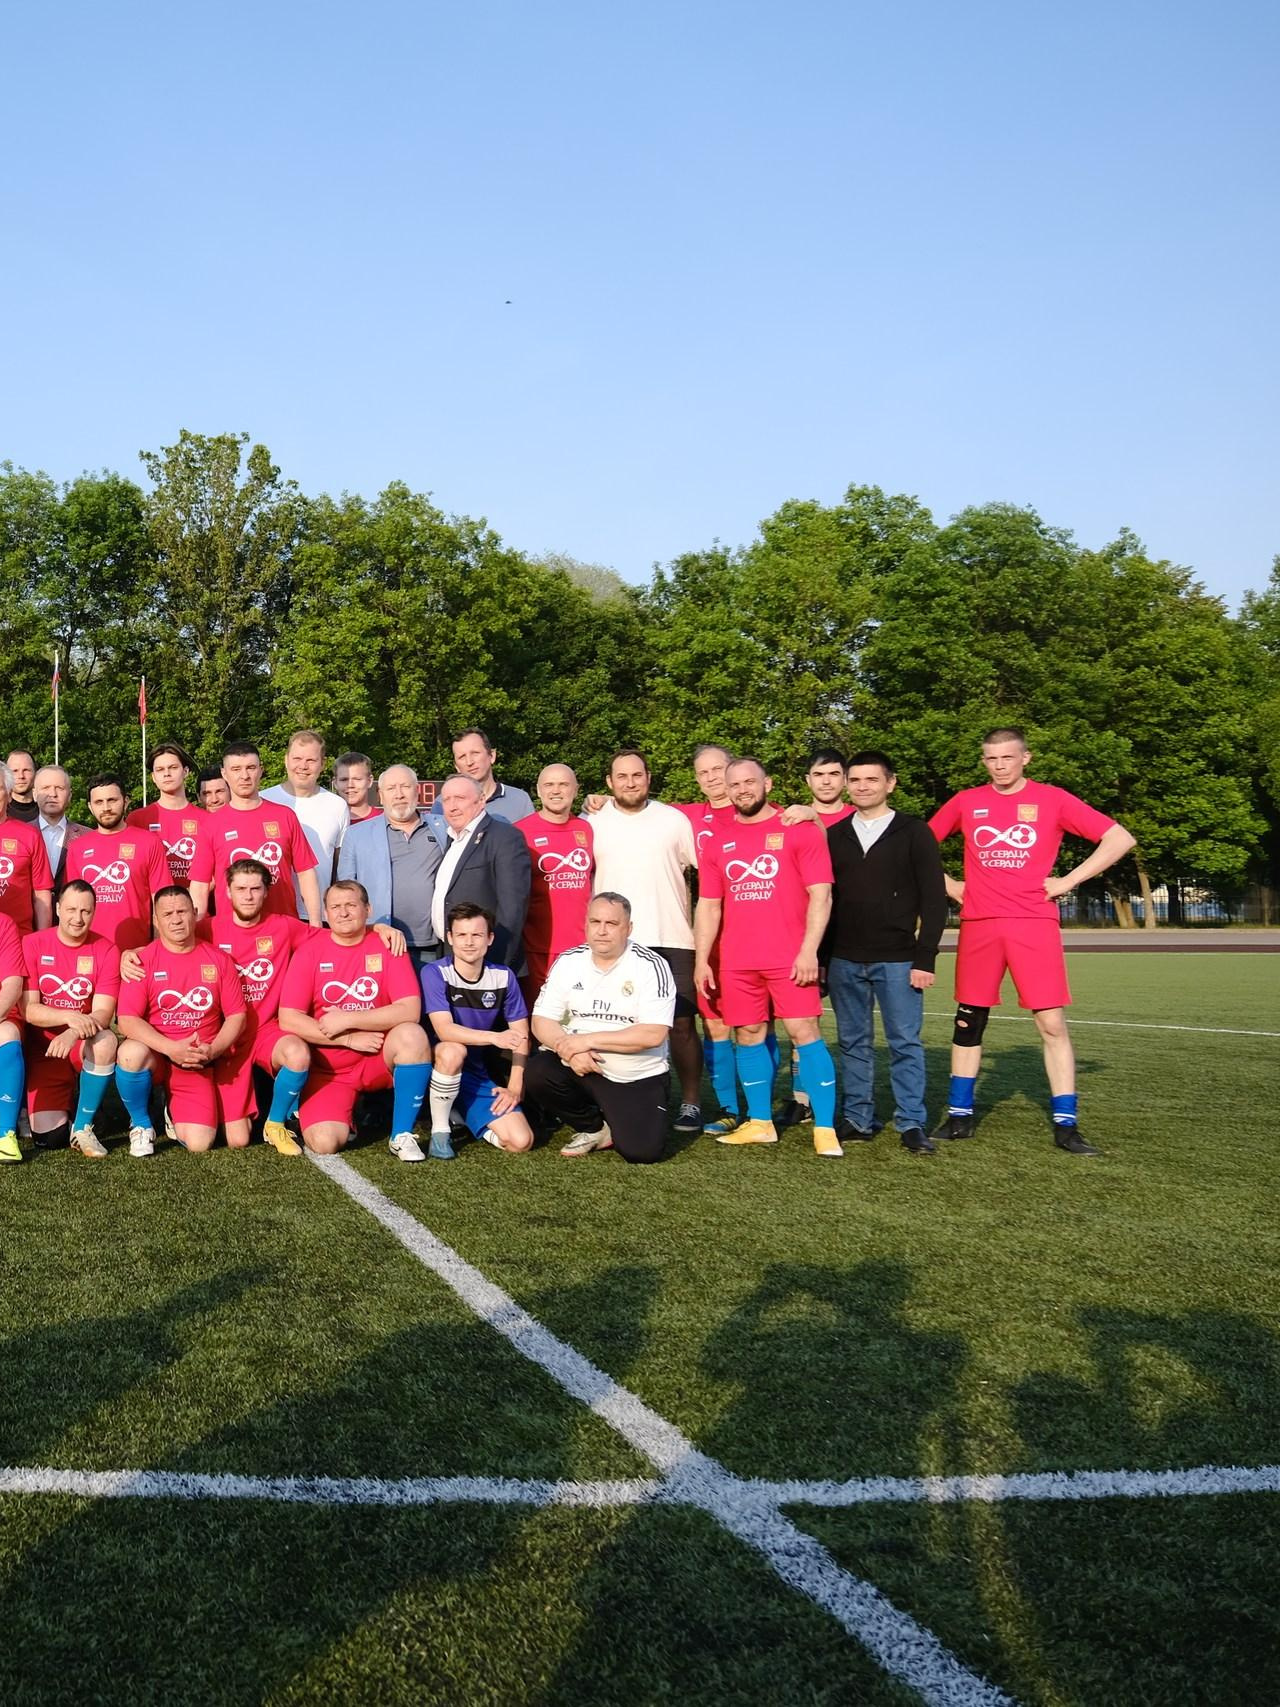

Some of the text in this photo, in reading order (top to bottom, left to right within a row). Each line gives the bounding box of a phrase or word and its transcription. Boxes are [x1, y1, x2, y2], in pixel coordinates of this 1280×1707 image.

[979, 850, 1030, 859] ОТ СЕРДЦА
[988, 860, 1026, 869] СЕРДЦУ
[544, 872, 587, 882] ОТ СЕРДЦА
[556, 881, 586, 889] СЕРДЦУ
[730, 881, 776, 893] ОТ СЕРДЦА
[740, 891, 772, 900] СЕРДЦУ
[241, 983, 269, 992] ЕРДЦА
[244, 992, 266, 1002] РДЦУ
[54, 999, 86, 1009] СЕРДЦА
[593, 1000, 611, 1012] Fly
[161, 1012, 172, 1020] ОТ
